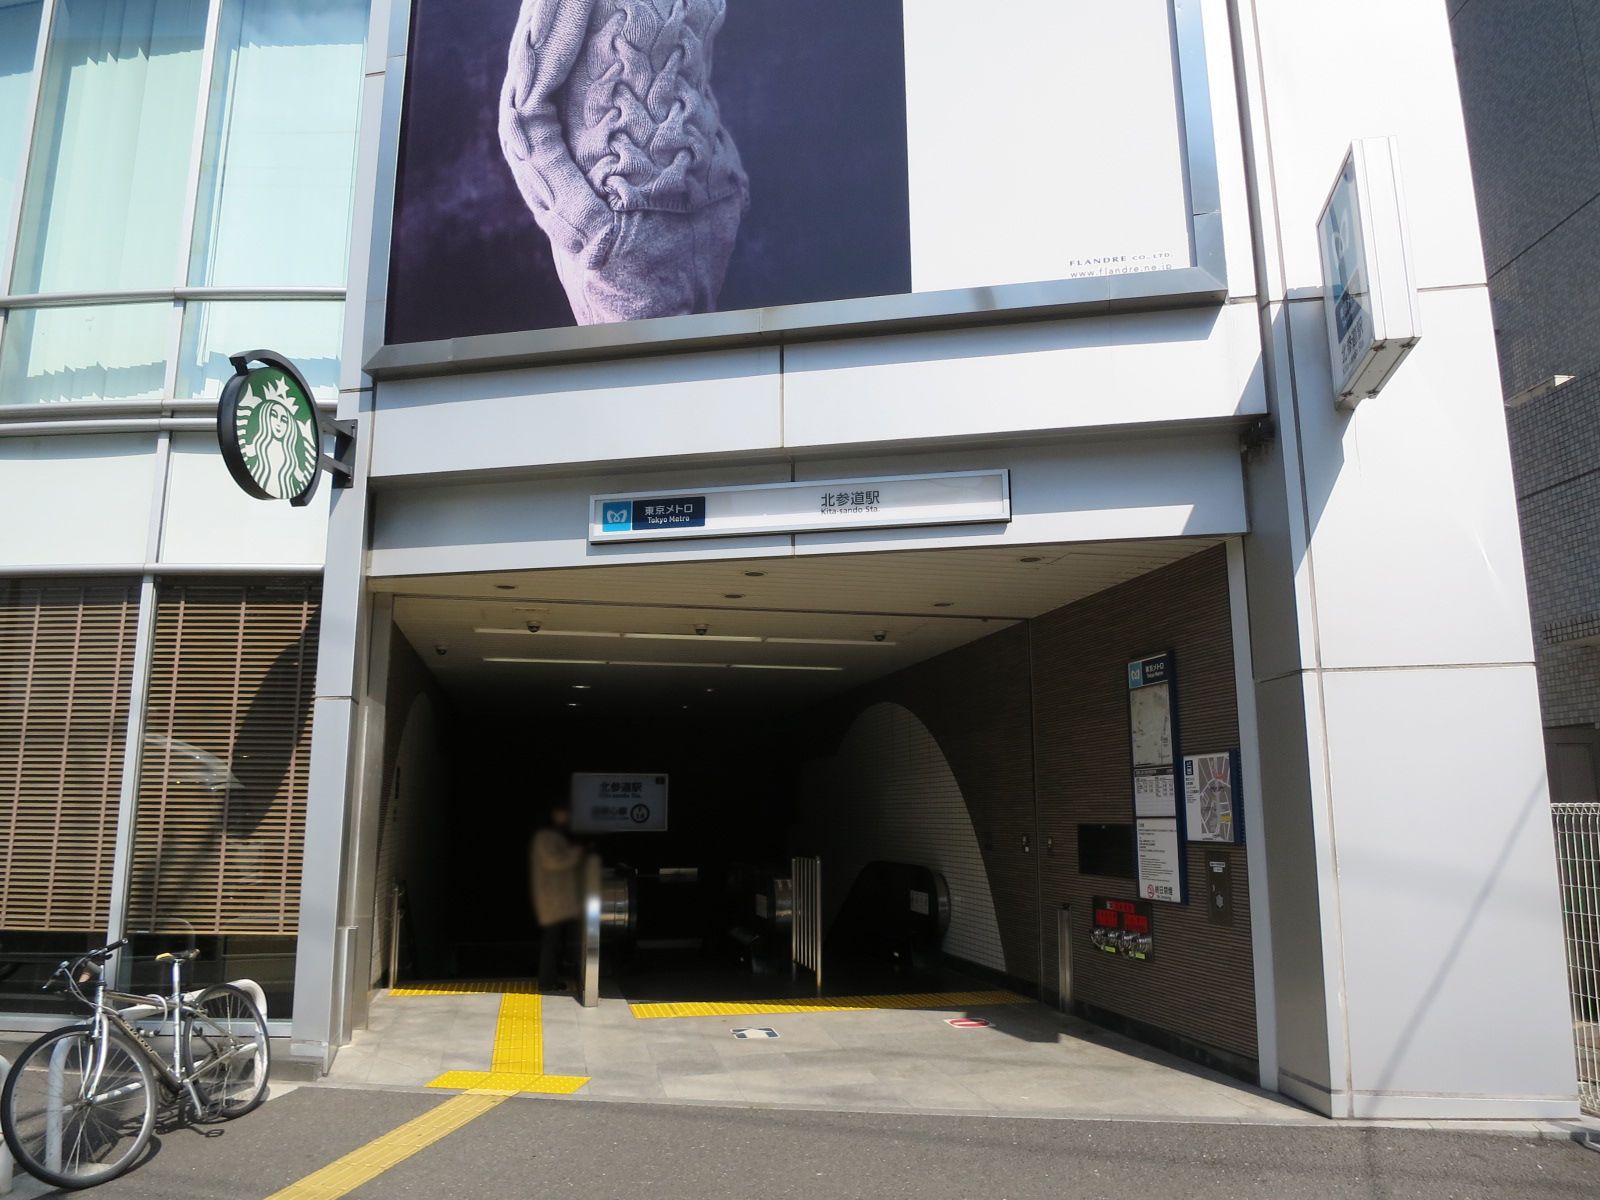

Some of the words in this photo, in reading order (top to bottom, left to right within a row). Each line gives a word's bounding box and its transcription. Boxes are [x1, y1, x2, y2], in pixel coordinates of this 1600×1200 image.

[1069, 255, 1127, 266] FLANDRE
[1070, 262, 1172, 278] www.flandre.ne.jp
[821, 490, 880, 507] 北参道駅
[644, 504, 693, 516] 東京メトロ
[821, 506, 863, 515] Kita-sando
[648, 516, 668, 524] Tokyo
[669, 515, 690, 523] Metro
